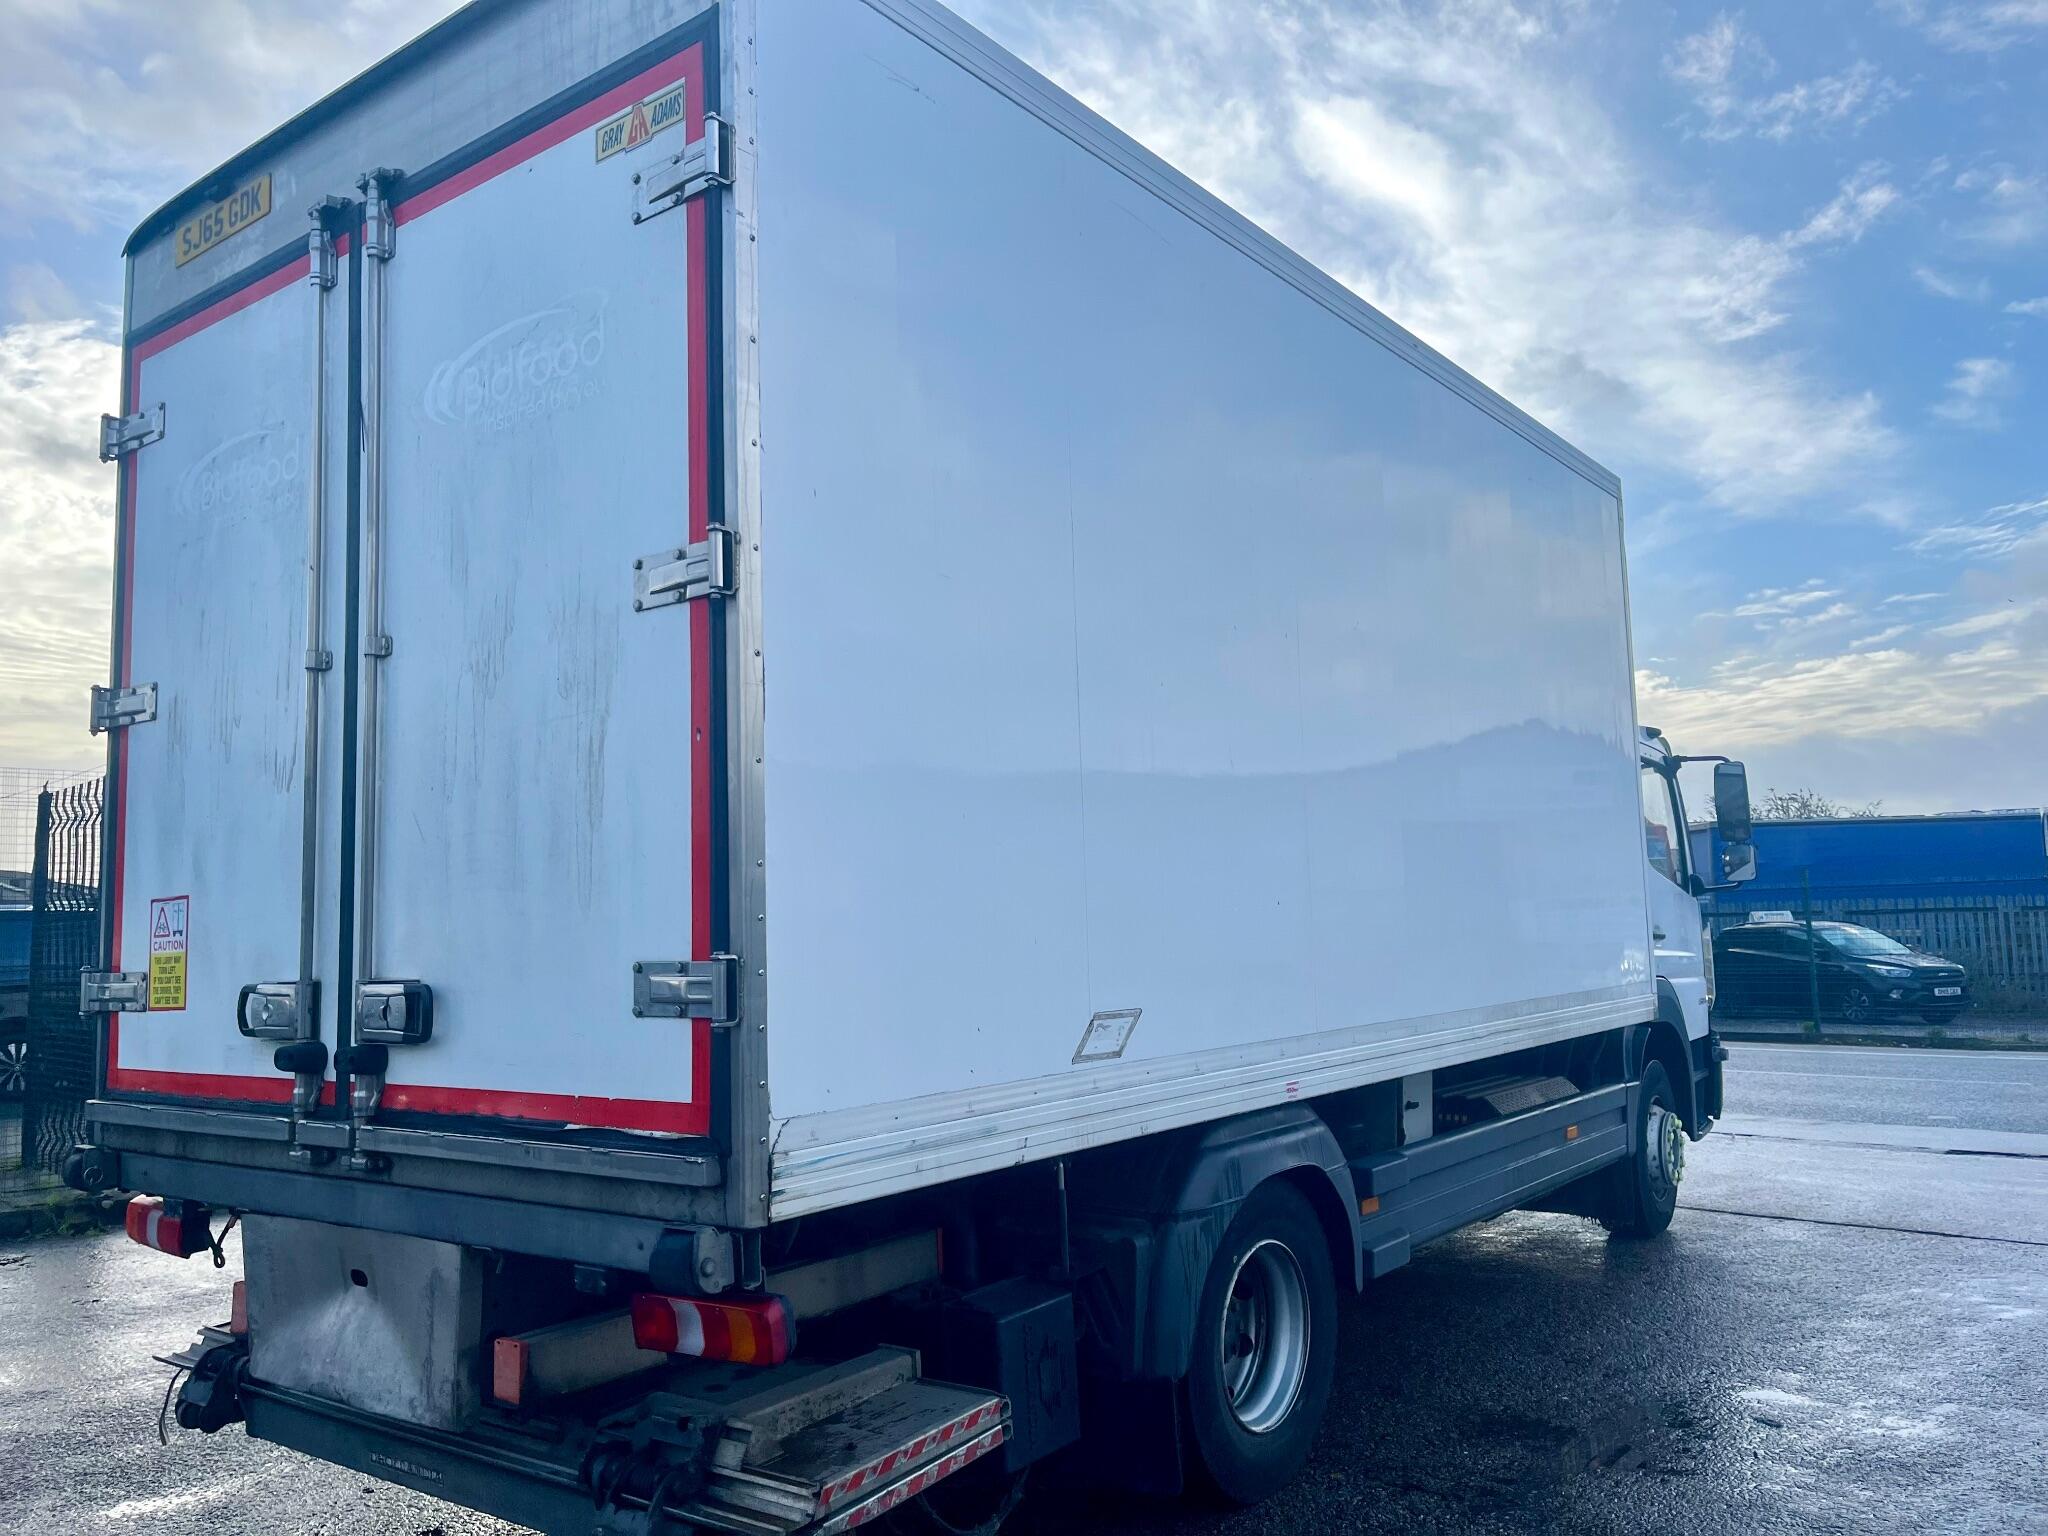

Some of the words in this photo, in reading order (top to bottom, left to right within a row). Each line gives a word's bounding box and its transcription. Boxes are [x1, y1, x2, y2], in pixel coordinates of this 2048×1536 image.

[602, 121, 625, 153] GRAY
[650, 92, 682, 129] ADAMS
[182, 206, 224, 256] SJ65
[228, 182, 262, 228] GDK
[153, 940, 184, 951] CAUTION
